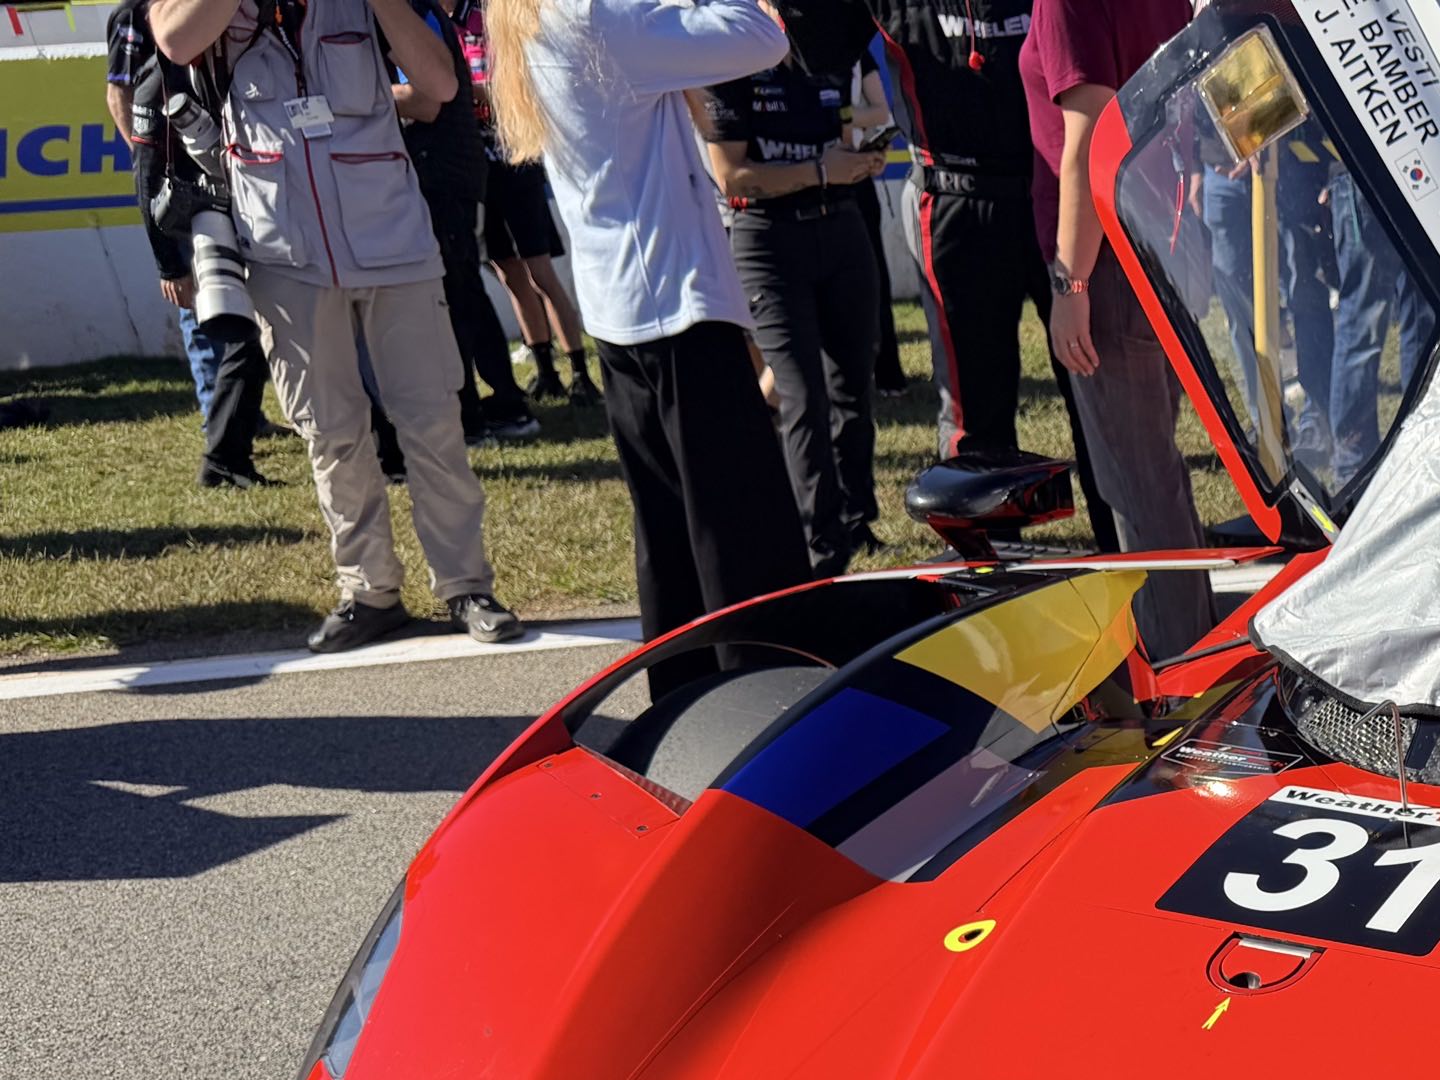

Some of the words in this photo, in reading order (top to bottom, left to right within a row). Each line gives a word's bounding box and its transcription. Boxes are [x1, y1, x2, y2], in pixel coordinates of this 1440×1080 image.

[1314, 9, 1340, 34] J.
[1330, 38, 1408, 147] AITKEN
[1359, 19, 1440, 146] BAMBER
[1386, 9, 1440, 88] VESTI
